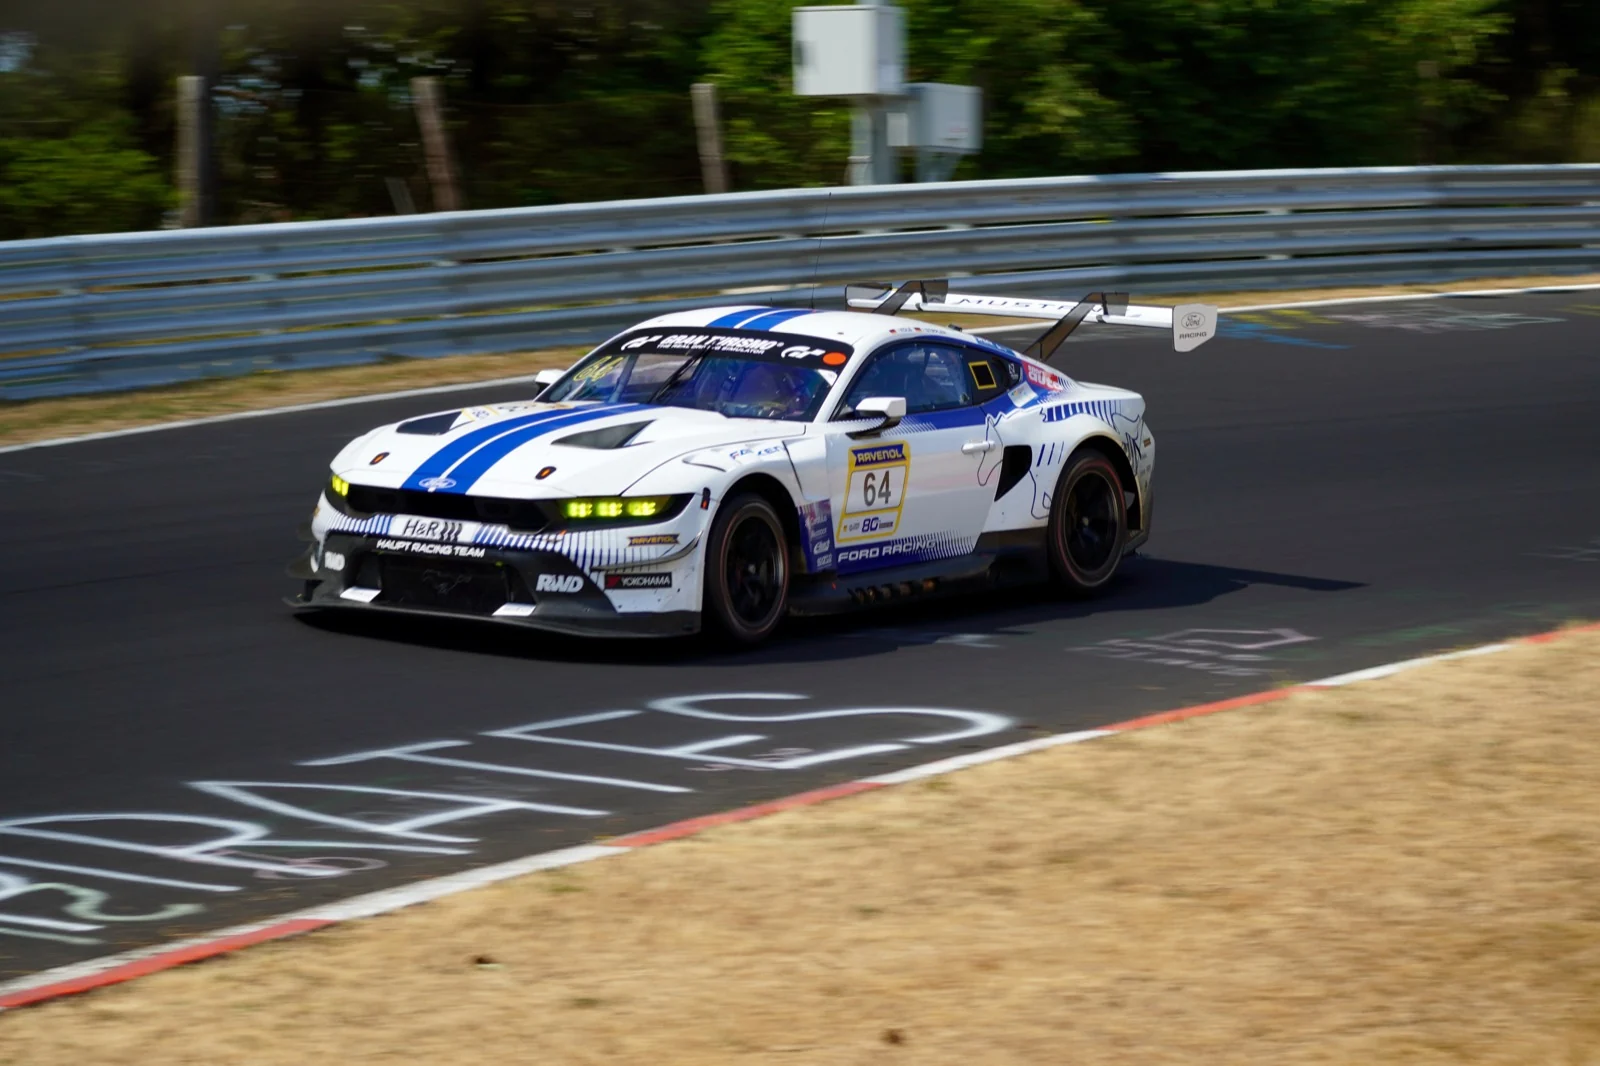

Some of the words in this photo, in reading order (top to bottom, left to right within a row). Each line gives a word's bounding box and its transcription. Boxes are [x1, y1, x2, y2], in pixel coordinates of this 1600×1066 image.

[659, 334, 710, 346] GRAN
[1179, 331, 1207, 340] RACING
[856, 448, 903, 463] RAVENOL
[863, 470, 892, 507] 64
[403, 518, 440, 537] H&R
[376, 539, 412, 551] HAUPT
[410, 543, 454, 556] RACING
[454, 546, 486, 558] TEAM
[838, 547, 880, 563] FORD
[882, 539, 937, 556] RACING
[535, 573, 585, 593] RWD
[621, 575, 671, 587] YOKOHAMA
